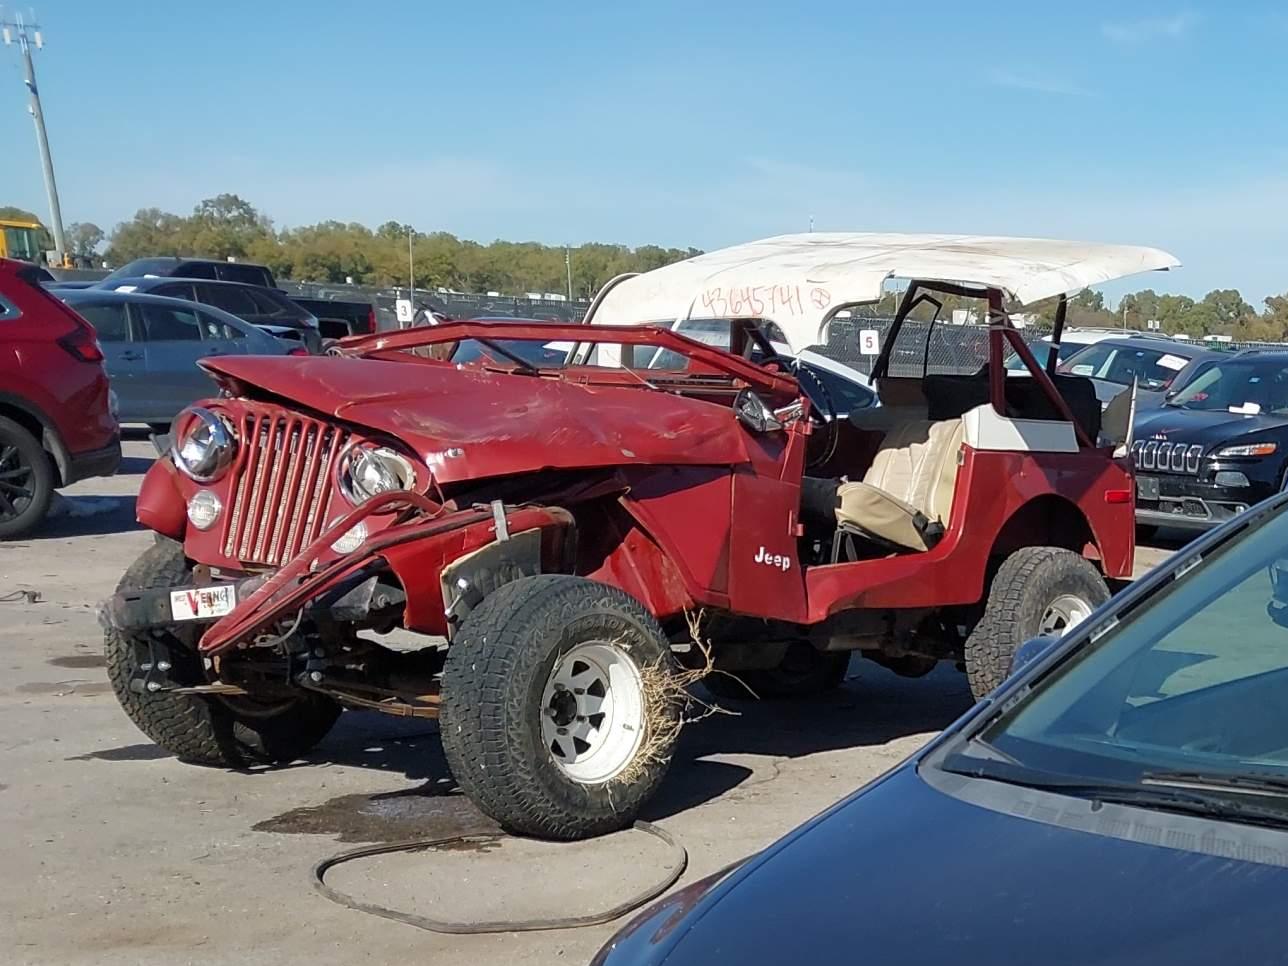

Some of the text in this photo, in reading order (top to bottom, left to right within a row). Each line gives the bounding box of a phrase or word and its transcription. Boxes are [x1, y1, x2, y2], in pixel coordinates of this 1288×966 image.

[401, 305, 408, 317] 3
[865, 336, 873, 349] 5
[754, 546, 791, 572] Jeep
